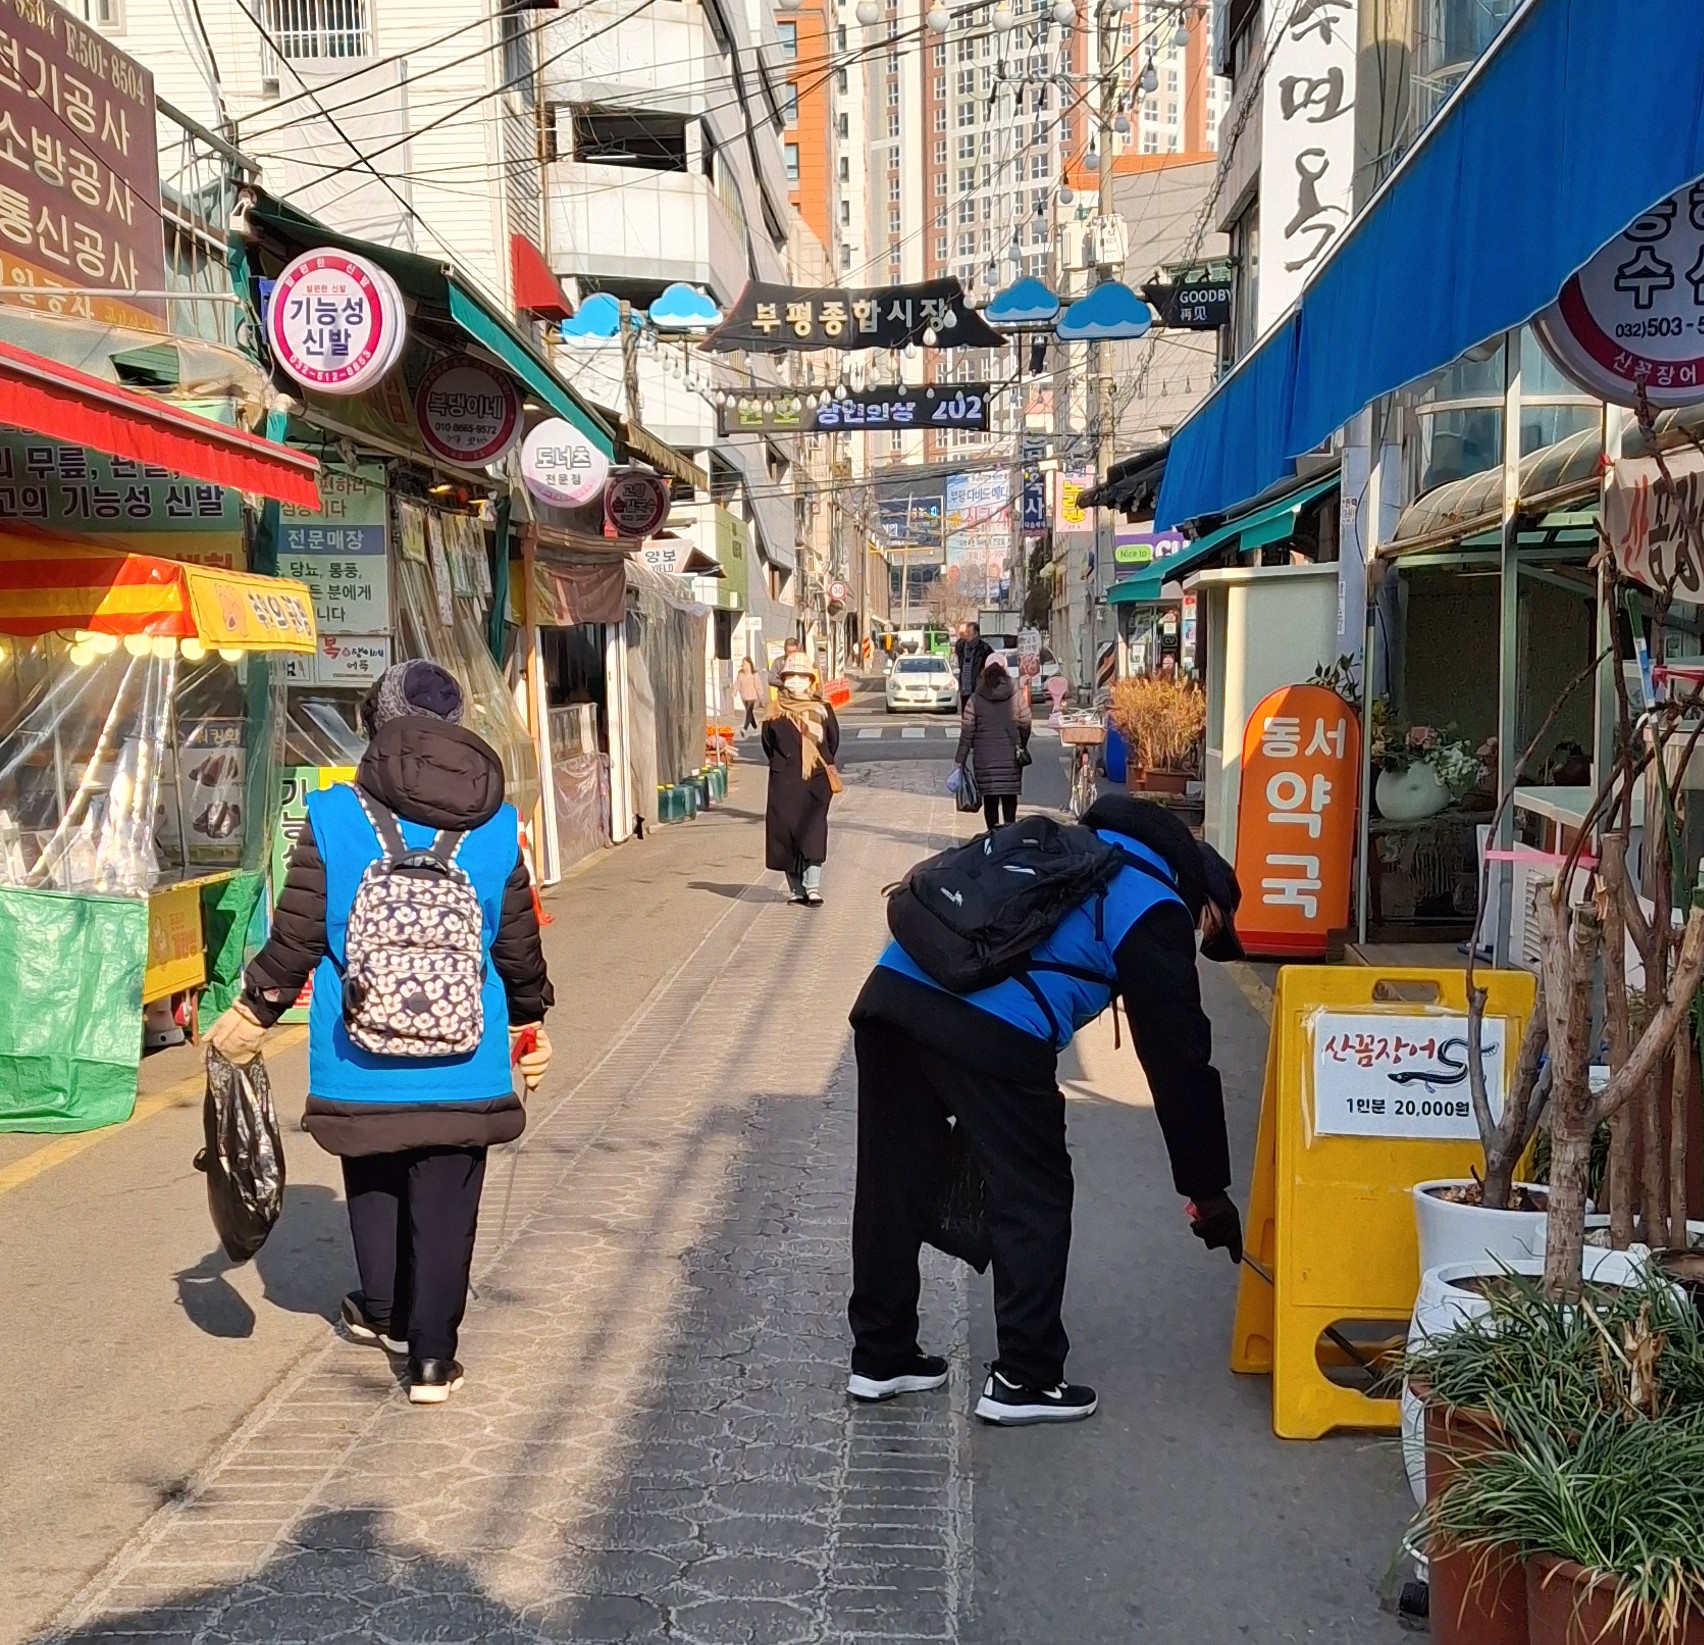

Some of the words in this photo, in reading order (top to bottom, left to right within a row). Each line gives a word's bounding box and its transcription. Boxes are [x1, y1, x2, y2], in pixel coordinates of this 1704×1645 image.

[0, 183, 139, 292] 통신공사
[290, 297, 364, 326] 기능성
[751, 298, 948, 338] 부평종합시장
[302, 328, 351, 356] 신발
[27, 446, 98, 480] 무릎,
[535, 445, 592, 470] 도너츠
[545, 474, 581, 486] 전문점
[61, 485, 152, 519] 기능성
[164, 484, 225, 518] 신발
[287, 529, 365, 551] 전문매장
[290, 561, 323, 580] 당뇨,
[328, 562, 363, 580] 통풍,
[645, 549, 676, 564] 양보
[327, 584, 372, 601] 분에게
[1261, 717, 1347, 759] 동서
[1325, 1033, 1436, 1067] 산꼼장어
[1346, 1098, 1386, 1115] 1인분
[1394, 1100, 1470, 1117] 20,000원
